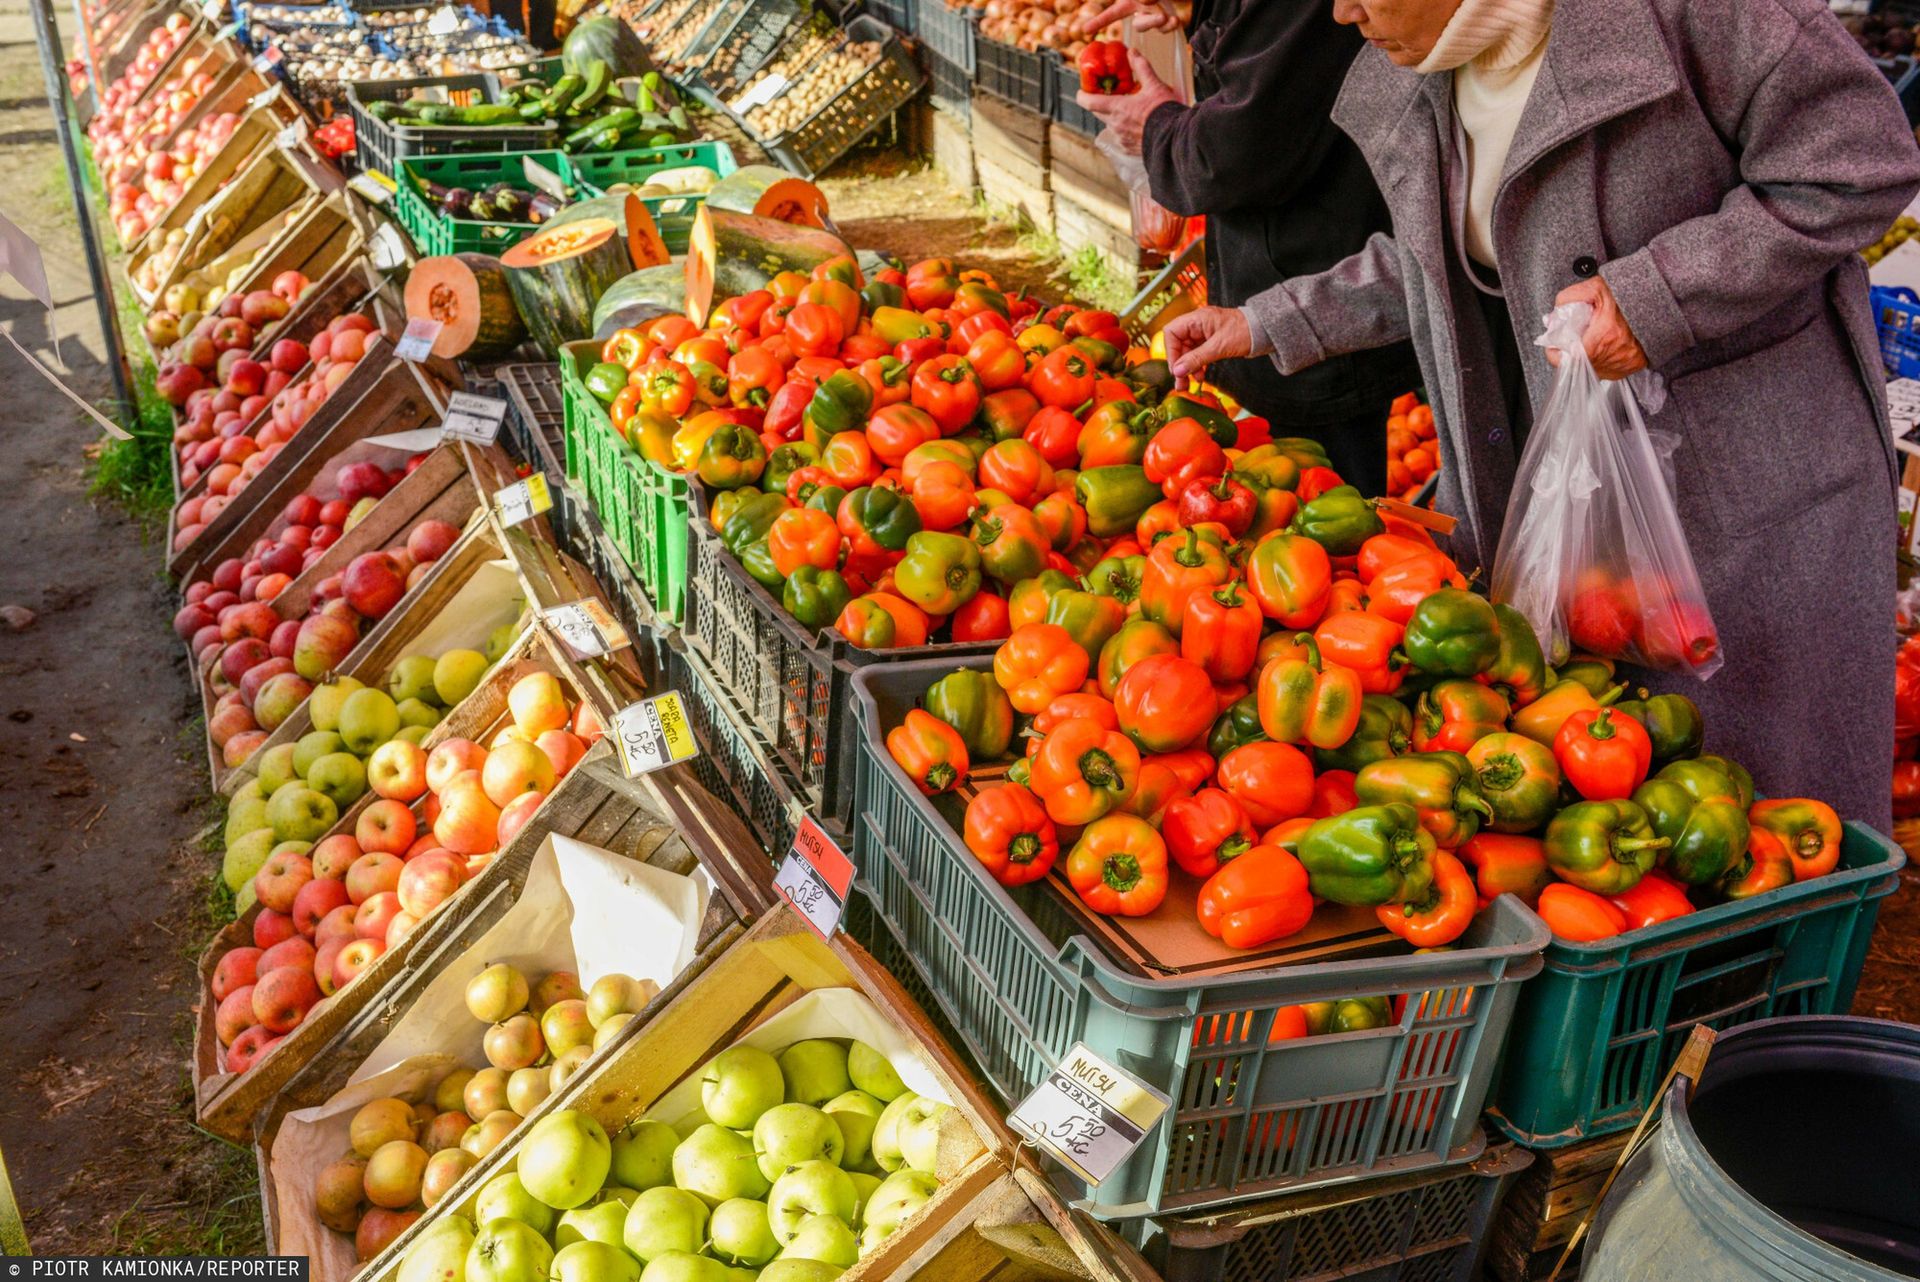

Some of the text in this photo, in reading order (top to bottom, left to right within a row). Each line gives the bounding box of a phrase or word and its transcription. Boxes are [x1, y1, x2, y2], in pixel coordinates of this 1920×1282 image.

[645, 705, 662, 740] CENA
[796, 856, 812, 875] CENA
[1056, 1078, 1102, 1118] CENA
